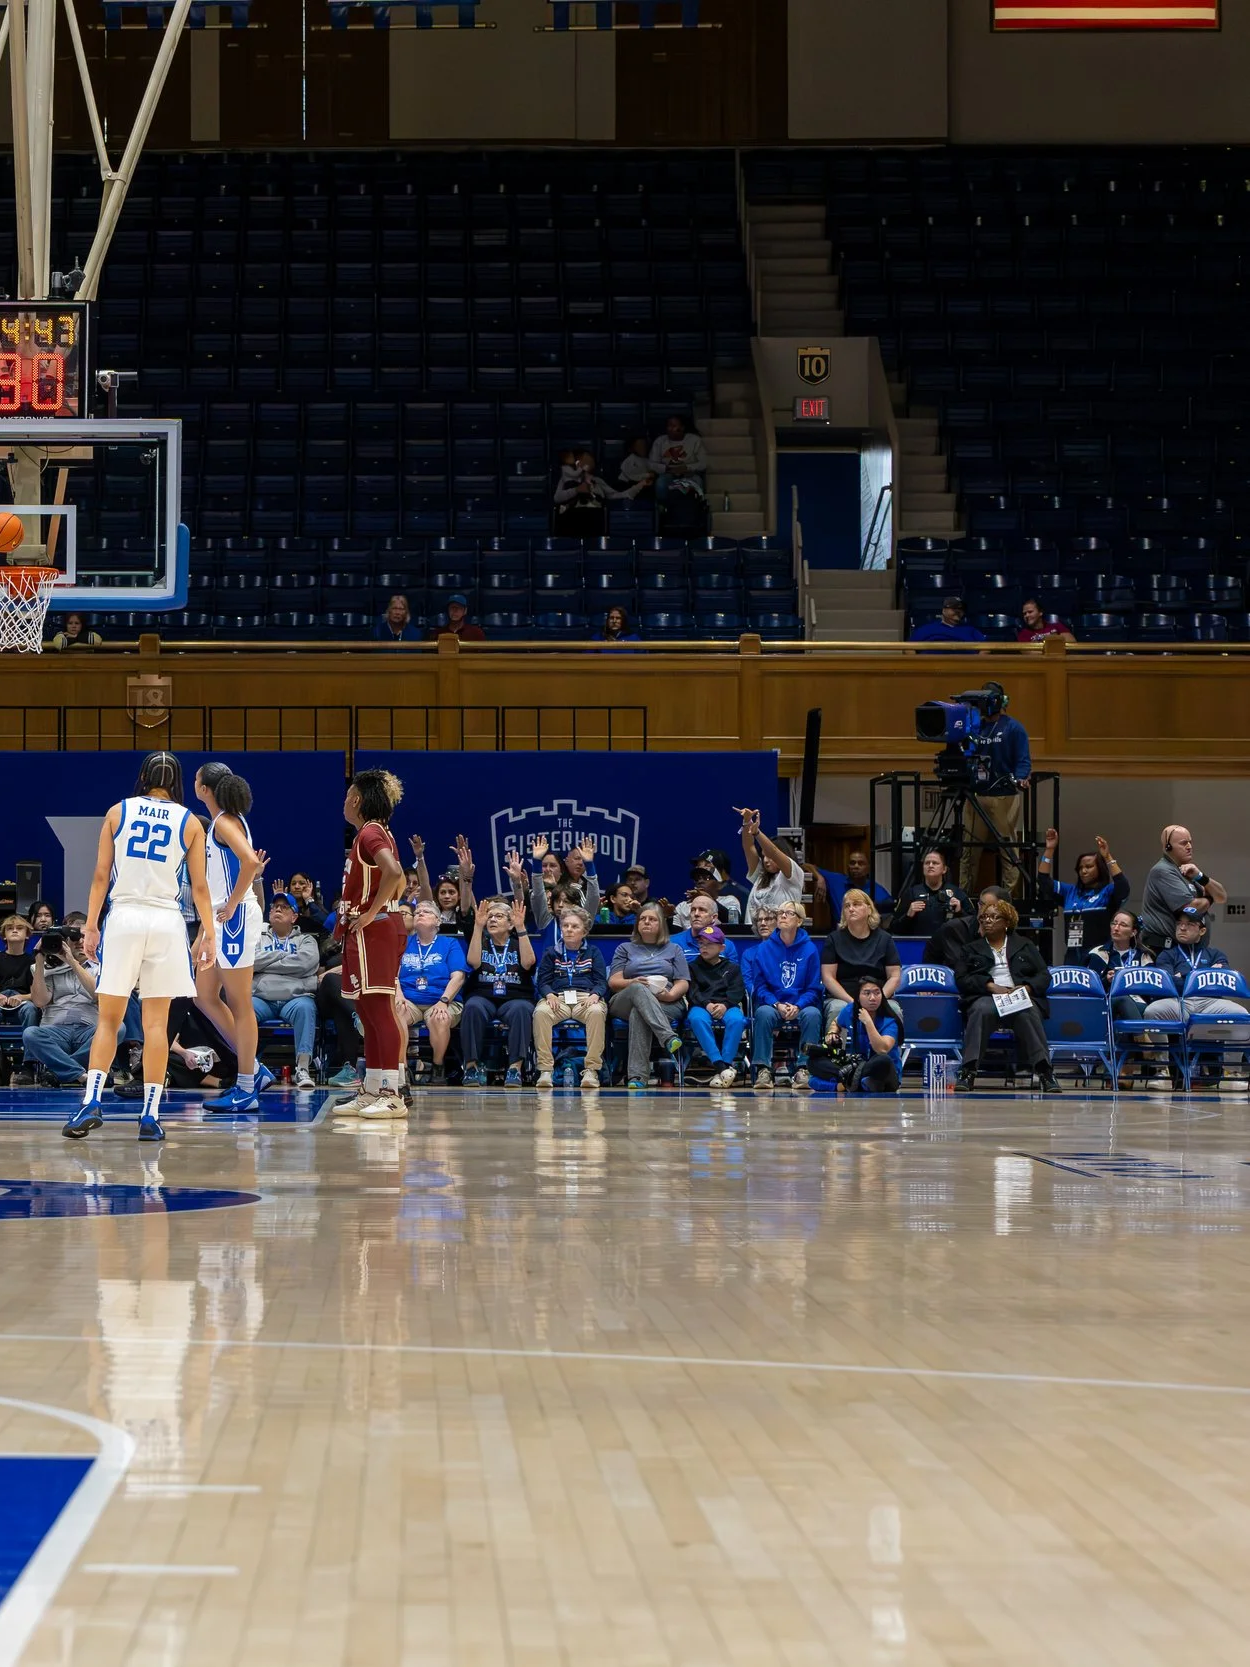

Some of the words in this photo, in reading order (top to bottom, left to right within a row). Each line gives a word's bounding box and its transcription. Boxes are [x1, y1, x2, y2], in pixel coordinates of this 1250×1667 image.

[803, 356, 826, 377] 10
[801, 400, 825, 417] EXIT
[129, 688, 166, 717] 18
[138, 805, 170, 820] MAIR
[557, 817, 573, 828] THE
[126, 820, 173, 863] 22
[227, 943, 240, 955] D
[907, 967, 946, 986] DUKE
[1052, 970, 1091, 988] DUKE
[1123, 970, 1163, 989] DUKE
[1197, 972, 1236, 991] DUKE
